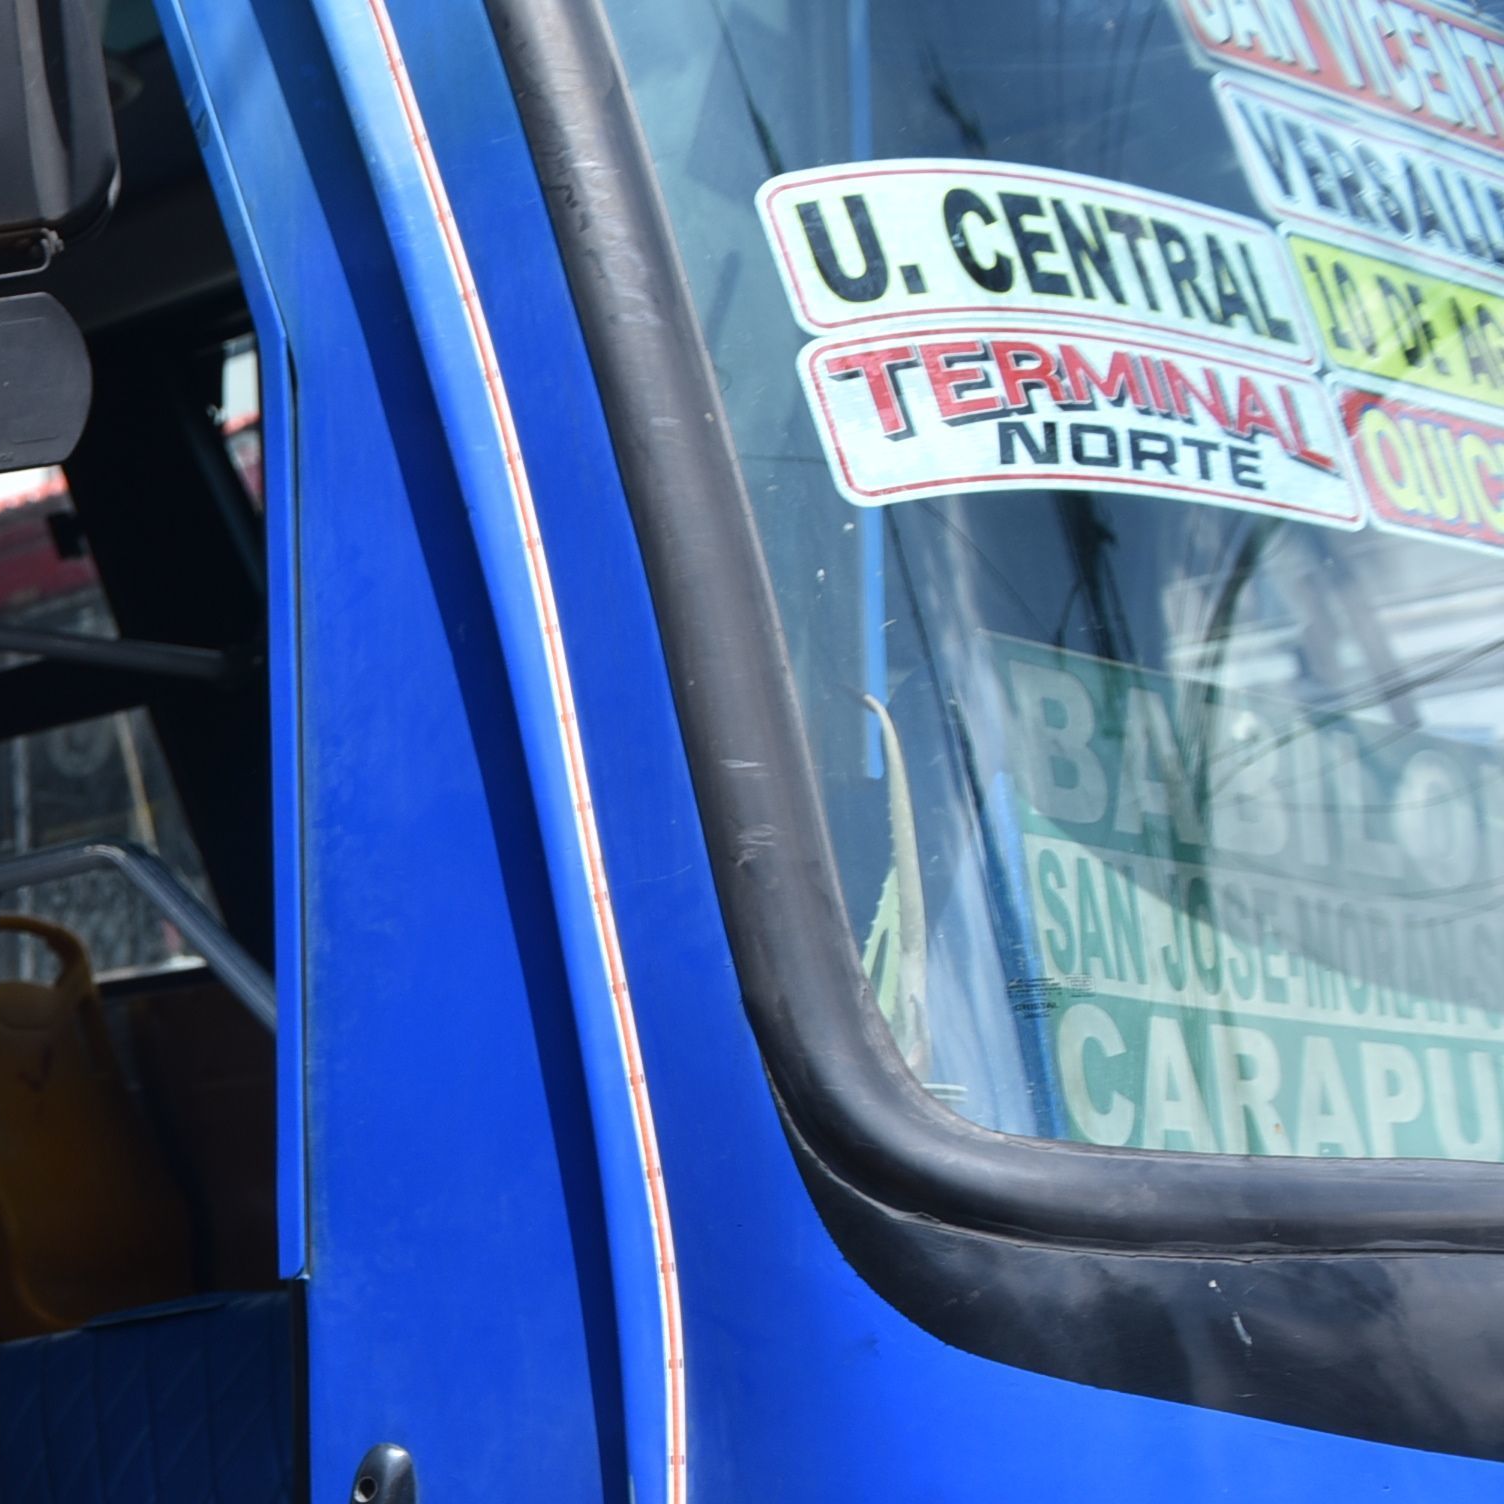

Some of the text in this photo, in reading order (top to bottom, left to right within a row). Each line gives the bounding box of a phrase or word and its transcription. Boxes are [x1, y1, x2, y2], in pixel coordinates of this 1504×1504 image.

[795, 188, 1297, 344] U. CENTRAL
[827, 340, 1341, 478] TERMINAL
[998, 421, 1267, 490] NORTE
[1009, 658, 1504, 888] BABILO
[1037, 846, 1149, 986] SAN
